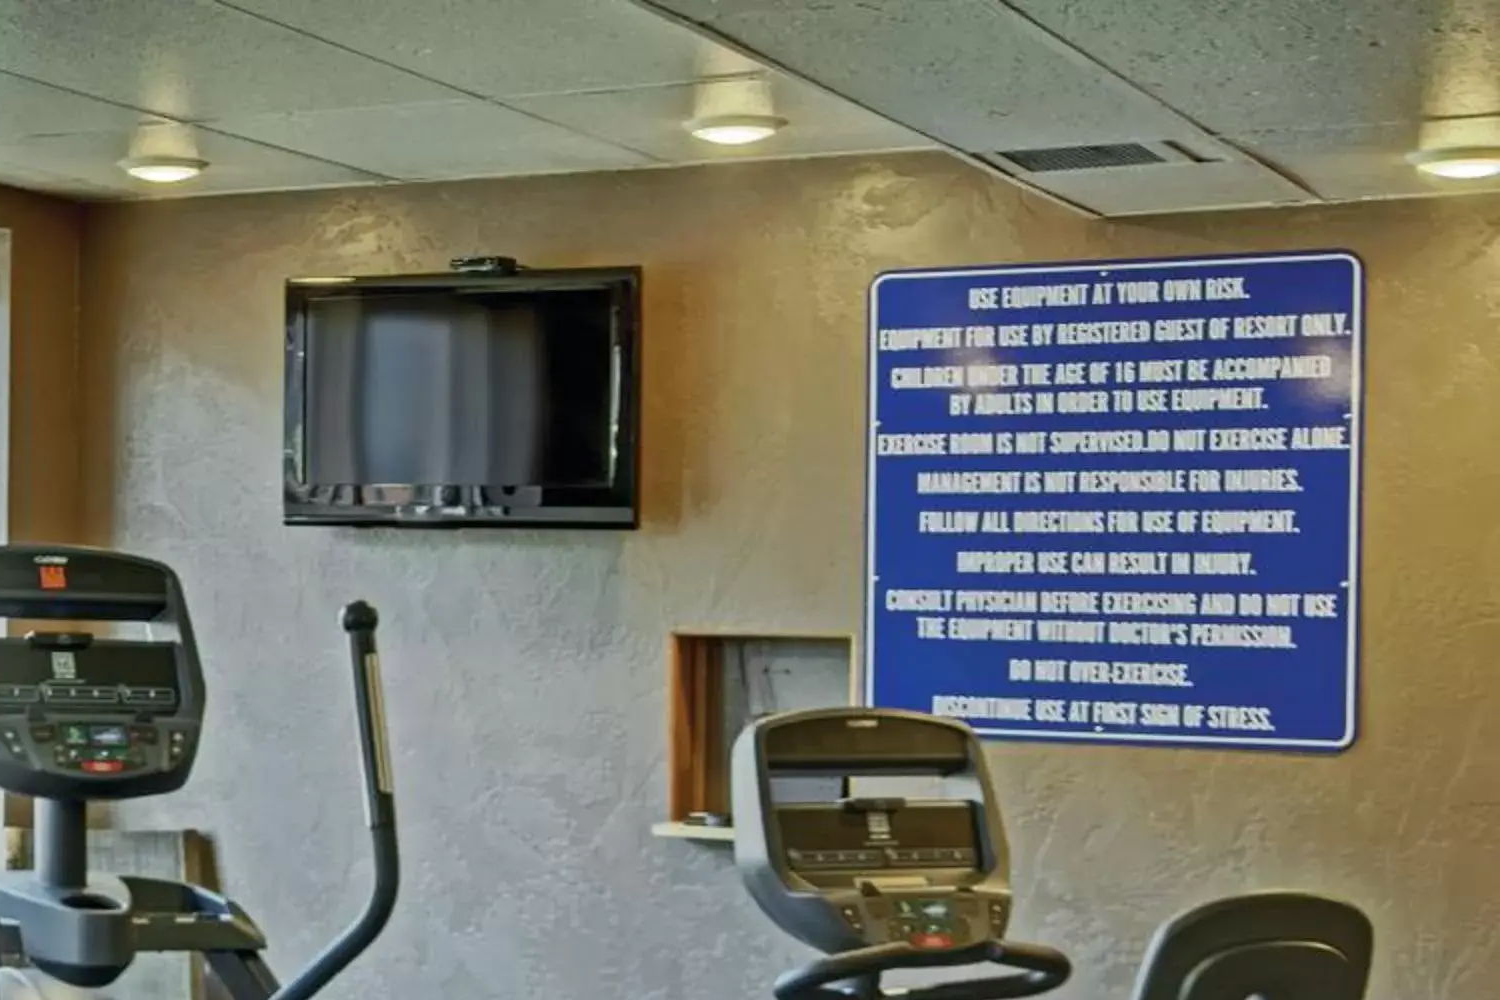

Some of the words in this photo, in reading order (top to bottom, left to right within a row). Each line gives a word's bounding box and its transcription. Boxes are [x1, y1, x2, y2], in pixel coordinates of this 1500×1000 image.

[969, 287, 998, 310] USE
[1092, 282, 1113, 305] AT
[1117, 280, 1159, 304] YOUR
[1163, 279, 1201, 302] OWN
[1205, 277, 1250, 300] RISK.
[965, 325, 994, 348] FOR
[998, 324, 1027, 347] USE
[1031, 323, 1053, 346] BY
[1057, 320, 1150, 345] REGISTERED
[1154, 318, 1204, 342] GUEST
[1208, 317, 1229, 340] OF
[1233, 315, 1296, 339] RESORT
[1300, 313, 1352, 337] ONLY.
[967, 364, 1018, 387] UNDER
[1022, 363, 1050, 385] THE
[1054, 362, 1085, 384] AGE
[1089, 361, 1110, 383] OF
[1114, 361, 1135, 383] 16
[1139, 359, 1183, 382] MUST
[1187, 359, 1208, 381] BE
[949, 394, 971, 416] BY
[975, 393, 1031, 415] ADULTS
[1035, 392, 1053, 414] IN
[1057, 391, 1108, 414] ORDER
[1112, 390, 1132, 413] TO
[1136, 390, 1167, 412] USE
[1171, 388, 1268, 411] EQUIPMENT.
[878, 433, 946, 455] EXERCISE
[950, 432, 992, 454] ROOM
[996, 432, 1012, 454] IS
[1016, 431, 1046, 453] NOT
[1050, 430, 1147, 453] SUPERVISED.
[1149, 429, 1169, 452] DO
[1173, 429, 1206, 451] NOT
[1210, 428, 1287, 451] EXERCISE
[1291, 427, 1351, 450] ALONE.
[917, 471, 1020, 494] MANAGEMENT
[1024, 471, 1040, 493] IS
[1044, 471, 1075, 493] NOT
[1079, 470, 1185, 493] RESPONSIBLE
[1189, 470, 1220, 492] FOR
[919, 511, 978, 533] FOLLOW
[982, 511, 1009, 533] ALL
[1013, 511, 1104, 533] DIRECTIONS
[1108, 510, 1138, 533] FOR
[1142, 510, 1173, 533] USE
[1177, 510, 1198, 533] OF
[1202, 510, 1300, 533] EQUIPMENT.
[957, 552, 1033, 574] IMPROPER
[1037, 552, 1067, 574] USE
[1071, 552, 1104, 574] CAN
[1108, 552, 1167, 575] RESULT
[1171, 552, 1189, 575] IN
[1193, 553, 1257, 575] INJURY.
[886, 590, 952, 612] CONSULT
[956, 590, 1037, 613] PHYSICIAN
[1041, 591, 1098, 614] BEFORE
[1102, 592, 1196, 616] EXERCISING
[1200, 593, 1234, 616] AND
[1238, 593, 1262, 617] DO
[1266, 594, 1299, 617] NOT
[1303, 594, 1337, 618] USE
[916, 618, 944, 640] THE
[1036, 620, 1105, 644] WITHOUT
[1109, 621, 1186, 645] DOCTOR'S
[1009, 660, 1030, 682] DO
[1034, 660, 1065, 683] NOT
[932, 695, 1031, 721] DISCONTINUE
[1035, 699, 1064, 722] USE
[1068, 700, 1089, 723] AT
[1093, 701, 1136, 725] FIRST
[1140, 703, 1179, 727] SIGN
[1183, 704, 1203, 728] OF
[1207, 705, 1275, 731] STRESS.
